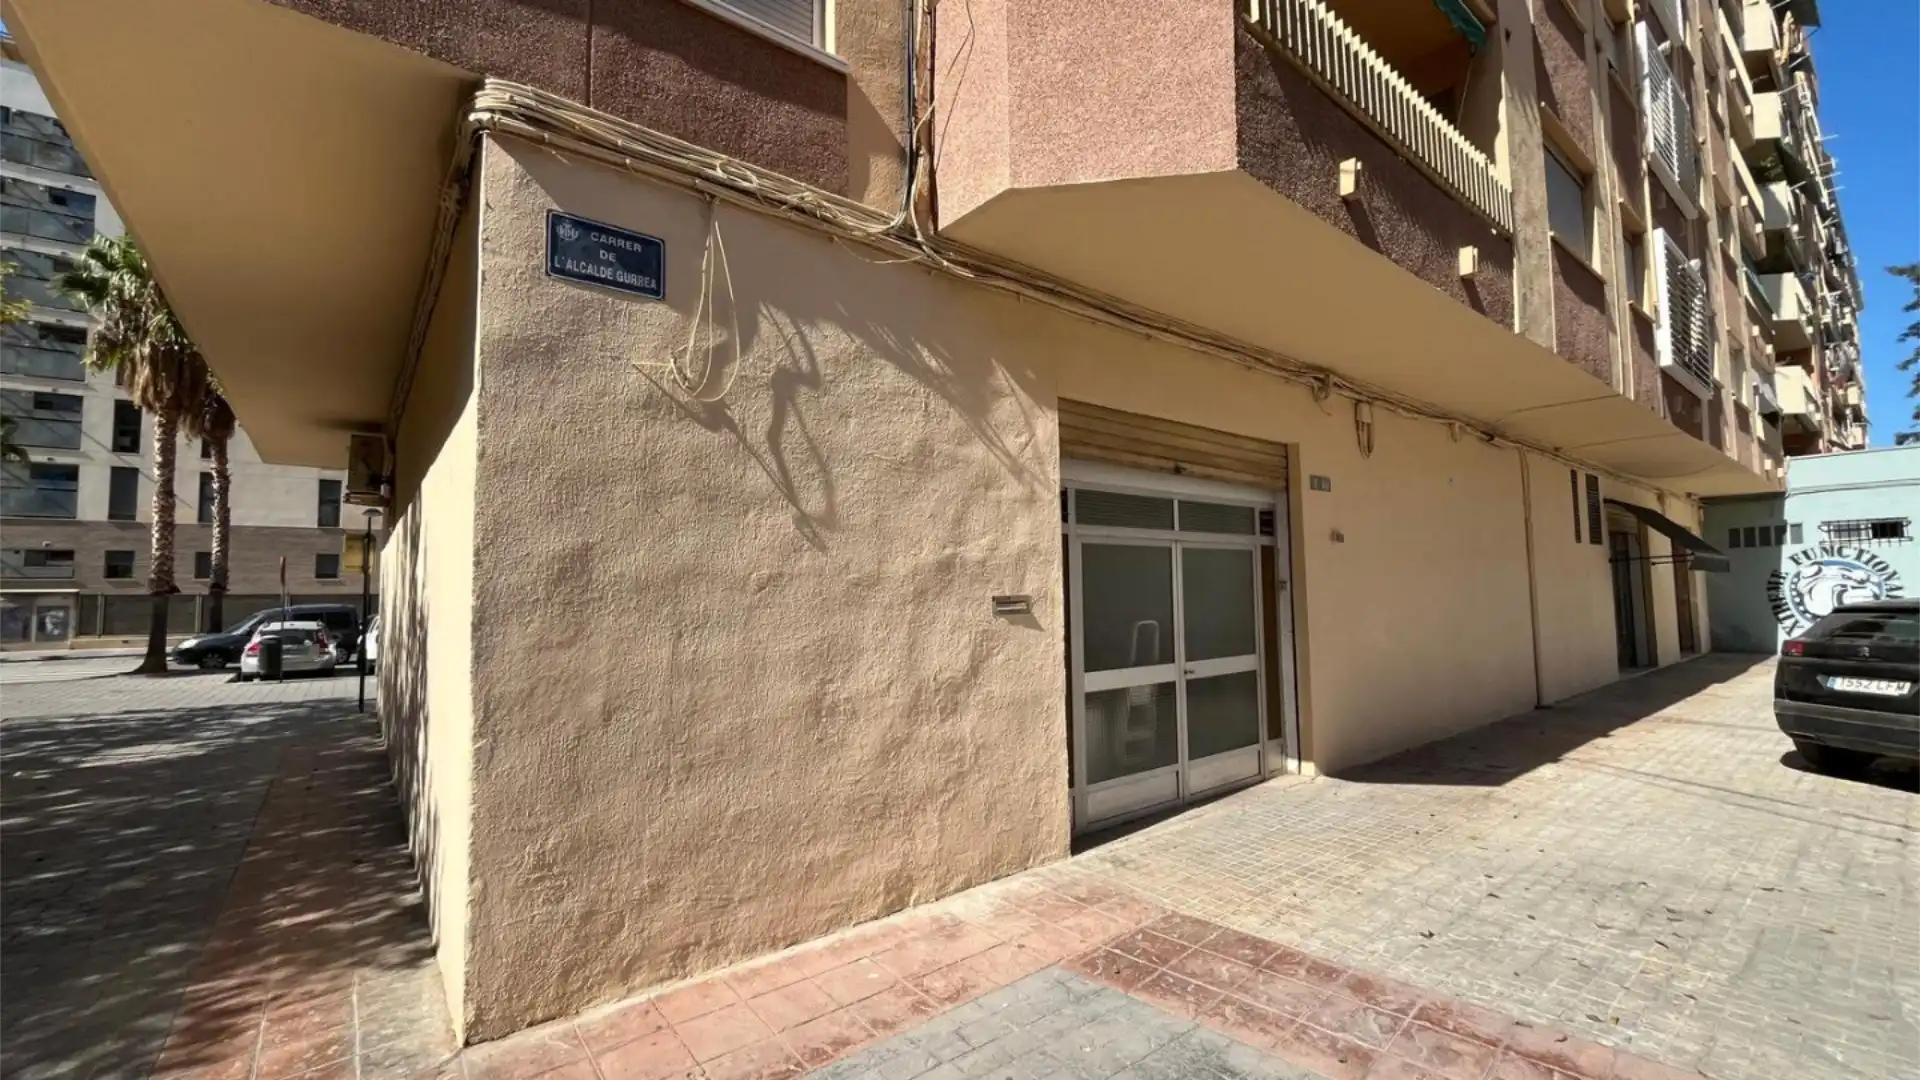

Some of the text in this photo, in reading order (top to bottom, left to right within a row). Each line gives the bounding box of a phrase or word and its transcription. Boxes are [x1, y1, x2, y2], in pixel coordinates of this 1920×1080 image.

[590, 232, 643, 253] CARRER
[599, 249, 617, 263] DE
[554, 255, 657, 290] L'ALCALDE GURREA
